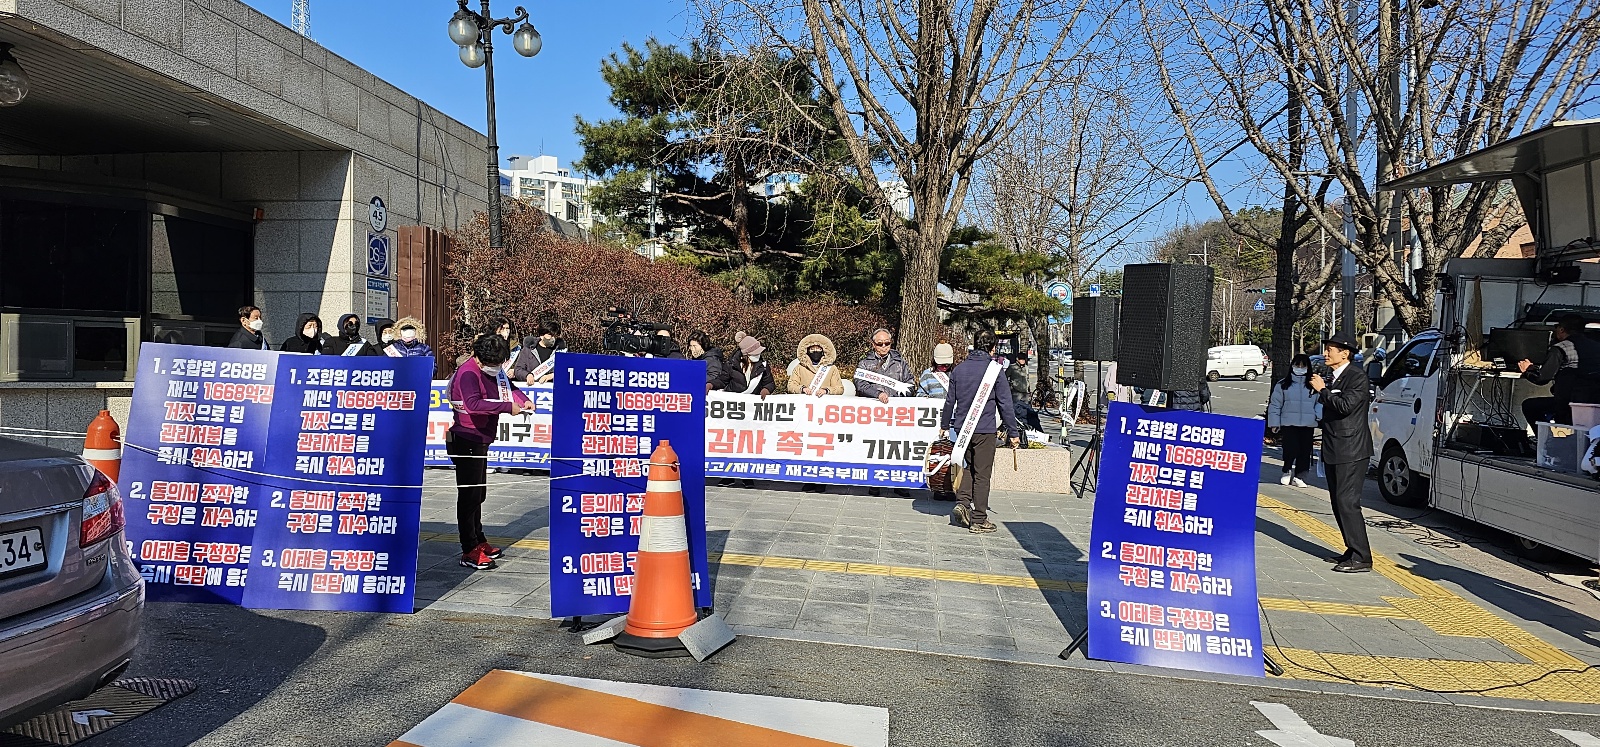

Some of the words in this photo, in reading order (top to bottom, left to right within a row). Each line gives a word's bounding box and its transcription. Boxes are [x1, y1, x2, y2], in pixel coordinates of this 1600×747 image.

[373, 210, 383, 221] 45
[154, 358, 166, 374] 1.
[171, 359, 217, 377] 조합원
[220, 362, 267, 381] 268명
[289, 369, 301, 385] 1.
[306, 369, 348, 387] 조합원
[351, 370, 394, 388] 268명
[568, 367, 580, 385] 1.
[585, 368, 625, 387] 조합원
[628, 371, 670, 389] 268명
[167, 381, 199, 399] 재산
[303, 389, 331, 409] 재산
[335, 390, 416, 411] 1668억강탈
[583, 390, 611, 409] 재산
[615, 392, 692, 412] 1668억강탈
[164, 401, 226, 423] 거짓으로
[229, 405, 244, 424] 된
[301, 411, 359, 431] 거짓으로
[362, 414, 375, 431] 된
[582, 412, 638, 433] 거짓으로
[642, 414, 655, 433] 된
[705, 401, 745, 420] 8명
[753, 403, 795, 421] 재산
[806, 404, 942, 427] 1,668억원강
[160, 424, 237, 446] 관리처분을
[708, 429, 766, 454] 감사
[1120, 417, 1132, 435] 1.
[1135, 419, 1178, 441] 조합원
[1180, 426, 1225, 446] 268명
[297, 433, 370, 454] 관리처분을
[582, 434, 651, 455] 관리처분을
[157, 447, 189, 466] 즉시
[191, 448, 253, 469] 취소하라
[296, 455, 324, 474] 즉시
[326, 455, 384, 476] 취소하라
[582, 458, 610, 478] 즉시
[1131, 441, 1161, 462] 재산
[1165, 445, 1247, 474] 1668억강탈
[786, 464, 868, 480] 재건축부패
[874, 468, 927, 483] 추방위
[1129, 462, 1186, 487] 거짓으로
[1189, 470, 1204, 489] 된
[130, 482, 145, 499] 2.
[150, 481, 199, 504] 동의서
[200, 484, 248, 505] 조작한
[271, 492, 286, 508] 2.
[289, 490, 337, 512] 동의서
[338, 491, 382, 513] 조작한
[562, 496, 577, 513] 2.
[580, 493, 623, 514] 동의서
[1125, 486, 1197, 512] 관리처분을
[147, 504, 196, 526] 구청은
[286, 513, 333, 534] 구청은
[338, 514, 397, 536] 자수하라
[1124, 508, 1152, 529] 즉시
[1154, 511, 1213, 536] 취소하라
[580, 517, 623, 537] 구청은
[0, 535, 31, 567] 34
[140, 539, 190, 563] 이태훈
[262, 550, 276, 568] 3.
[280, 549, 327, 571] 이태훈
[329, 549, 389, 572] 구청장은
[1101, 542, 1116, 559] 2.
[1120, 542, 1164, 567] 동의서
[1166, 547, 1212, 572] 조작한
[562, 556, 577, 573] 3.
[580, 553, 623, 574] 이태훈
[140, 565, 170, 584] 즉시
[174, 565, 222, 587] 면담에
[278, 572, 308, 592] 즉시
[310, 573, 358, 594] 면담에
[363, 574, 406, 595] 응하라
[582, 578, 611, 596] 즉시
[1119, 565, 1164, 589] 구청은
[1170, 571, 1232, 597] 자수하라
[1100, 601, 1116, 619] 3.
[1118, 601, 1164, 626] 이태훈
[1167, 608, 1229, 632] 구청장은
[1120, 626, 1149, 648] 즉시
[1152, 628, 1201, 653] 면담에
[1206, 635, 1252, 658] 응하라
